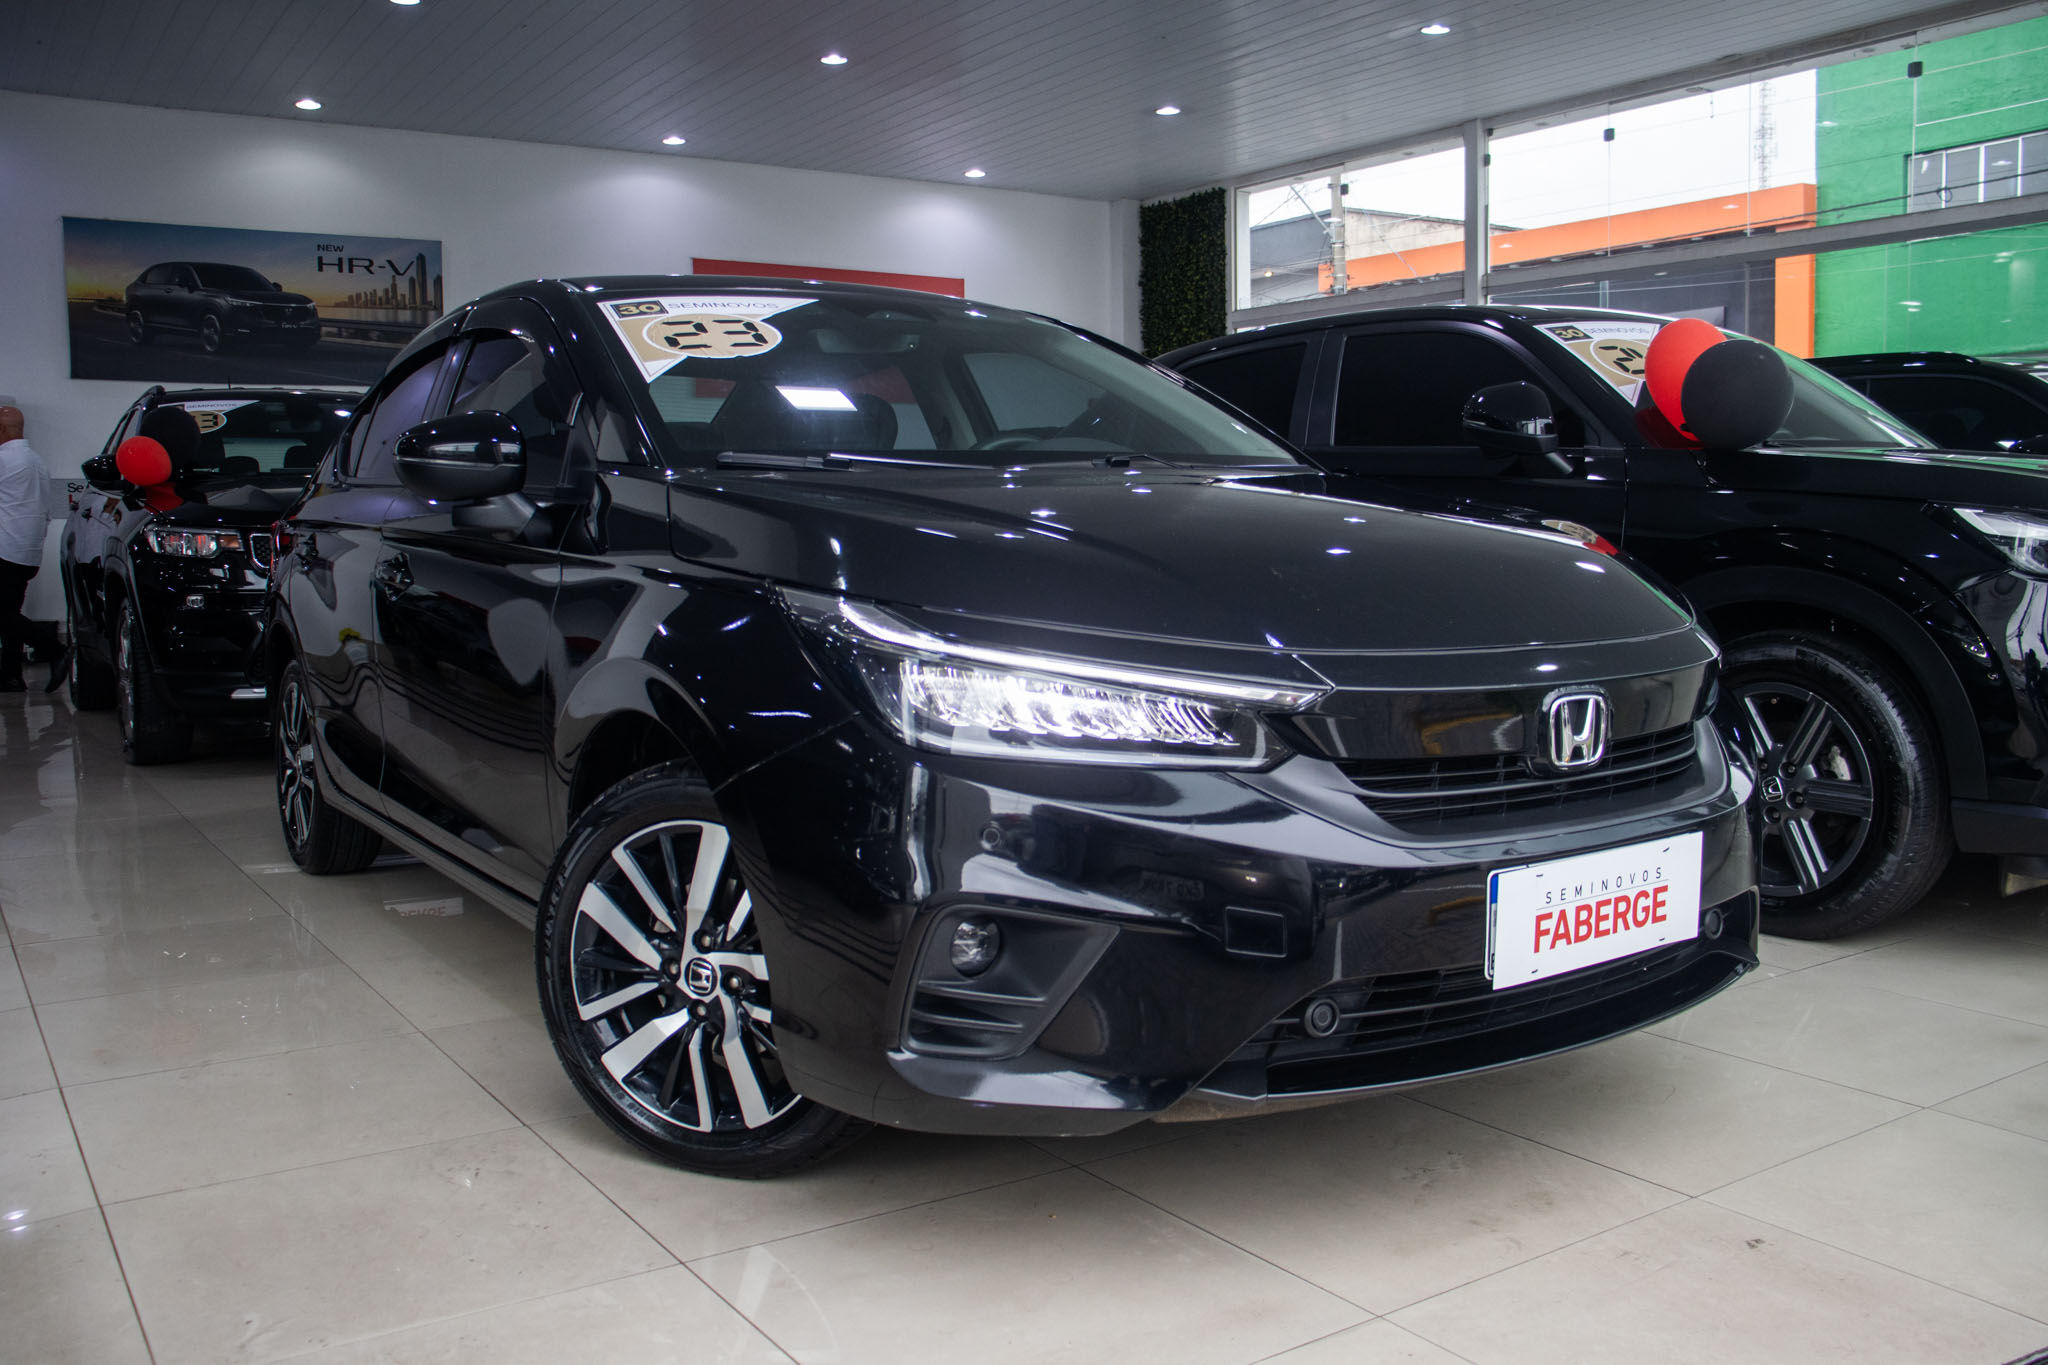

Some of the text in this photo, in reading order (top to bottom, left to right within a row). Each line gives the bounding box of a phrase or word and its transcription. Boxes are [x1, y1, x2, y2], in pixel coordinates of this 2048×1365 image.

[317, 244, 344, 252] NEW
[317, 255, 414, 276] HR-V
[618, 303, 661, 315] 30
[662, 319, 769, 350] 23
[1555, 329, 1584, 339] 30
[1598, 345, 1645, 375] 2
[1545, 867, 1662, 904] SEMINOVOS
[1533, 885, 1669, 954] FABERGE
